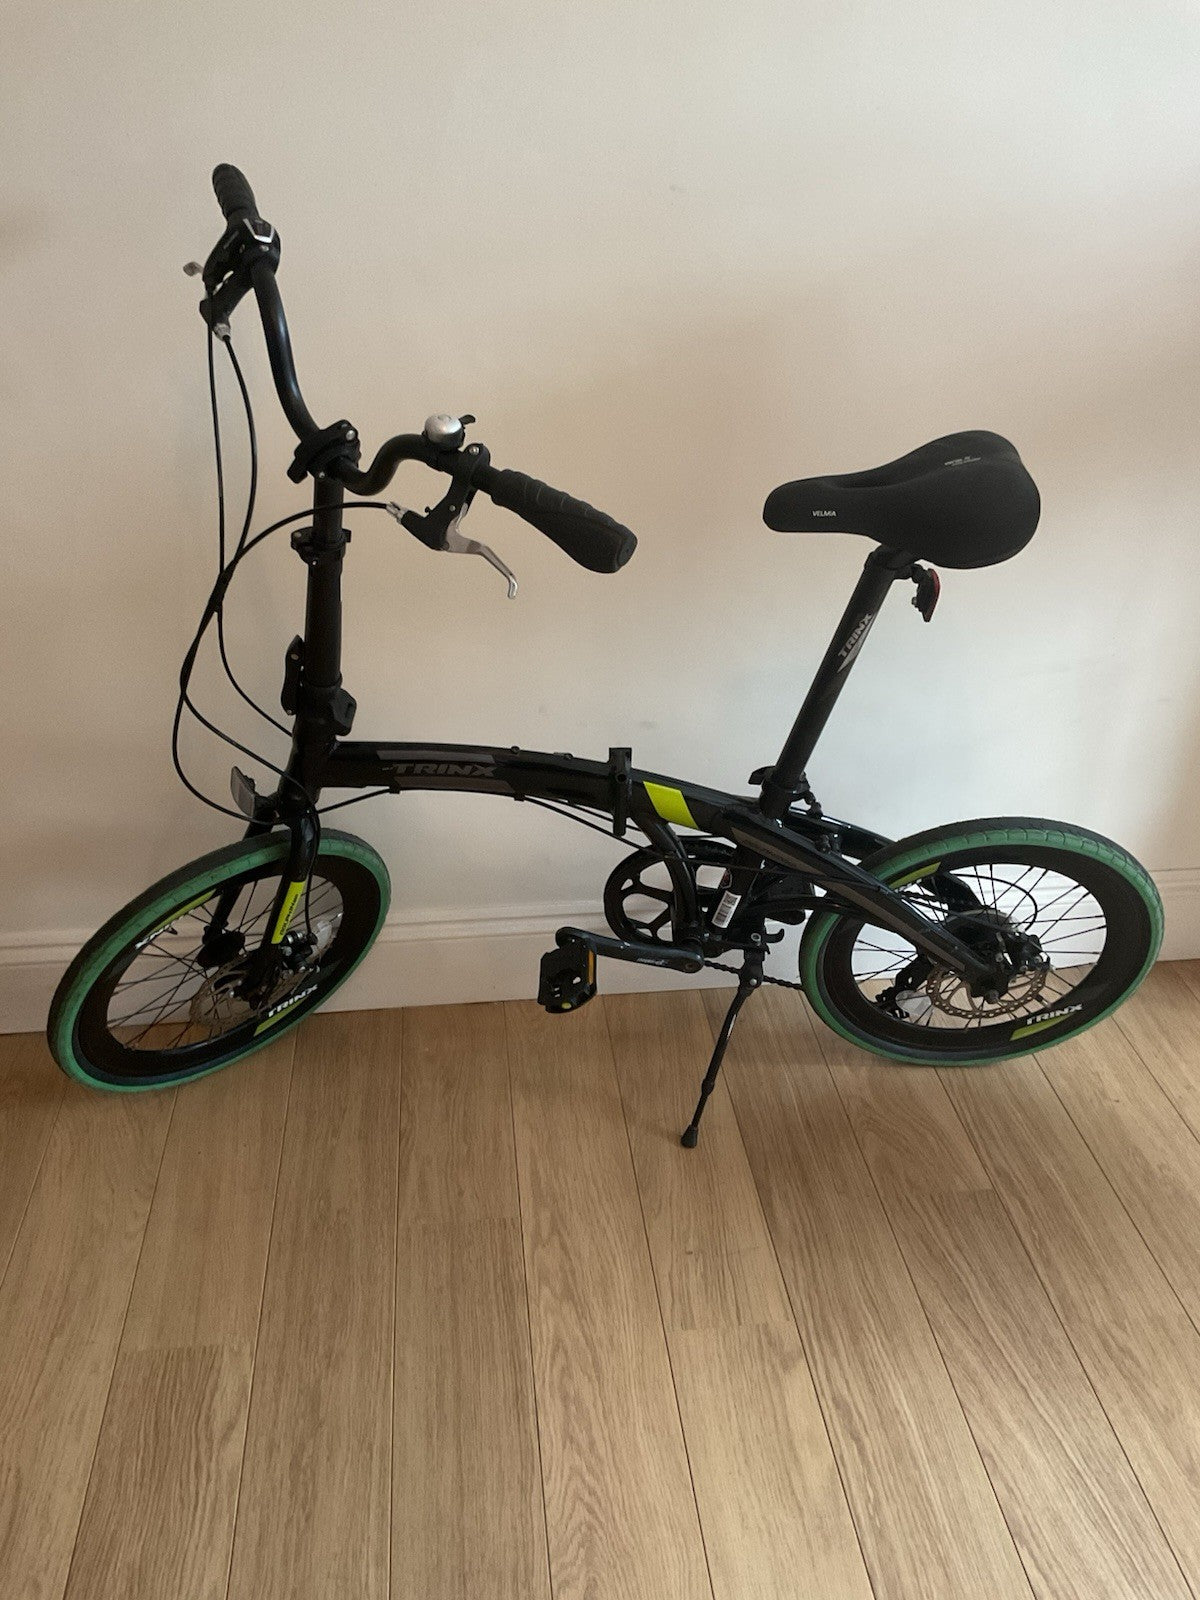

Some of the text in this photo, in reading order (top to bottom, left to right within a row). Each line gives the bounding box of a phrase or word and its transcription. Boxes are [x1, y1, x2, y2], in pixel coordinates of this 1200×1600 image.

[837, 613, 873, 658] TRINX
[389, 762, 499, 778] TRINX
[268, 983, 319, 1018] TRINX
[1026, 1003, 1083, 1026] TRINX
